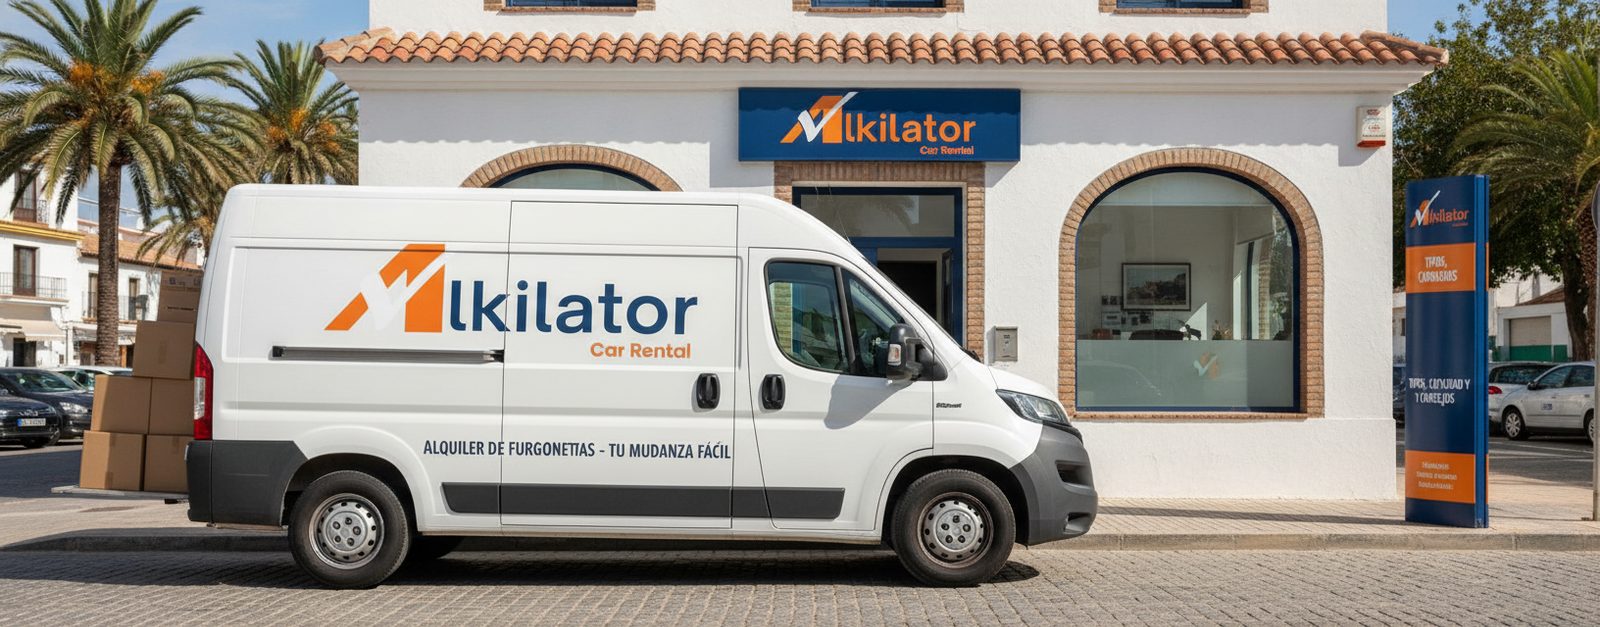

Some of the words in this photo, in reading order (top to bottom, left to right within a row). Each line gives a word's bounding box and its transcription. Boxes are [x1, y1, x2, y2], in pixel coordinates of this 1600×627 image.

[324, 243, 698, 335] Alkilator
[590, 342, 625, 358] Car
[630, 342, 691, 359] Rental
[423, 440, 484, 456] ALQUILER
[488, 441, 505, 456] DE
[608, 443, 625, 457] TU
[629, 443, 694, 458] MUDANZA
